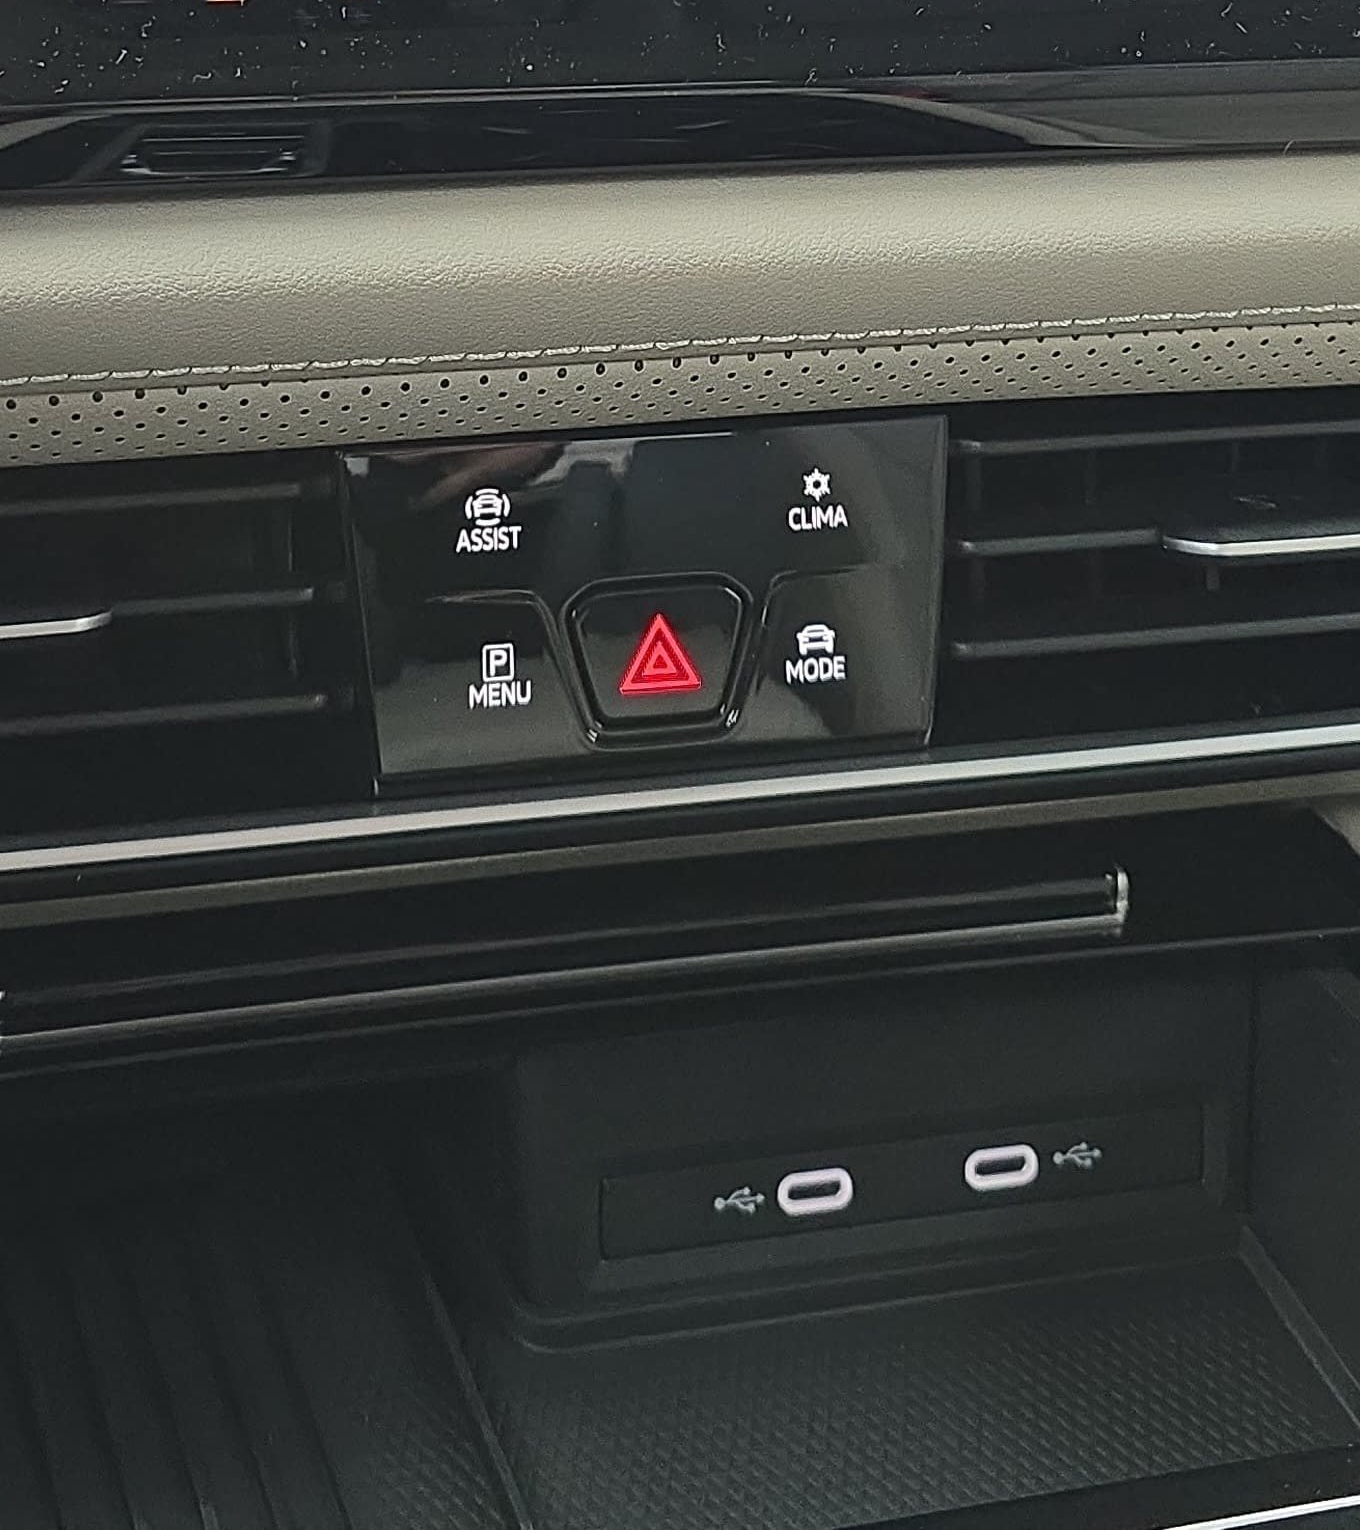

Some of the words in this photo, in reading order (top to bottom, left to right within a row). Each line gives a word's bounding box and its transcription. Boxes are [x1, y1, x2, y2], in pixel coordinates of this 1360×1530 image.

[787, 505, 849, 532] CLIMA
[455, 525, 522, 554] ASSIST
[785, 654, 847, 684] MODE
[468, 680, 532, 709] MENU
